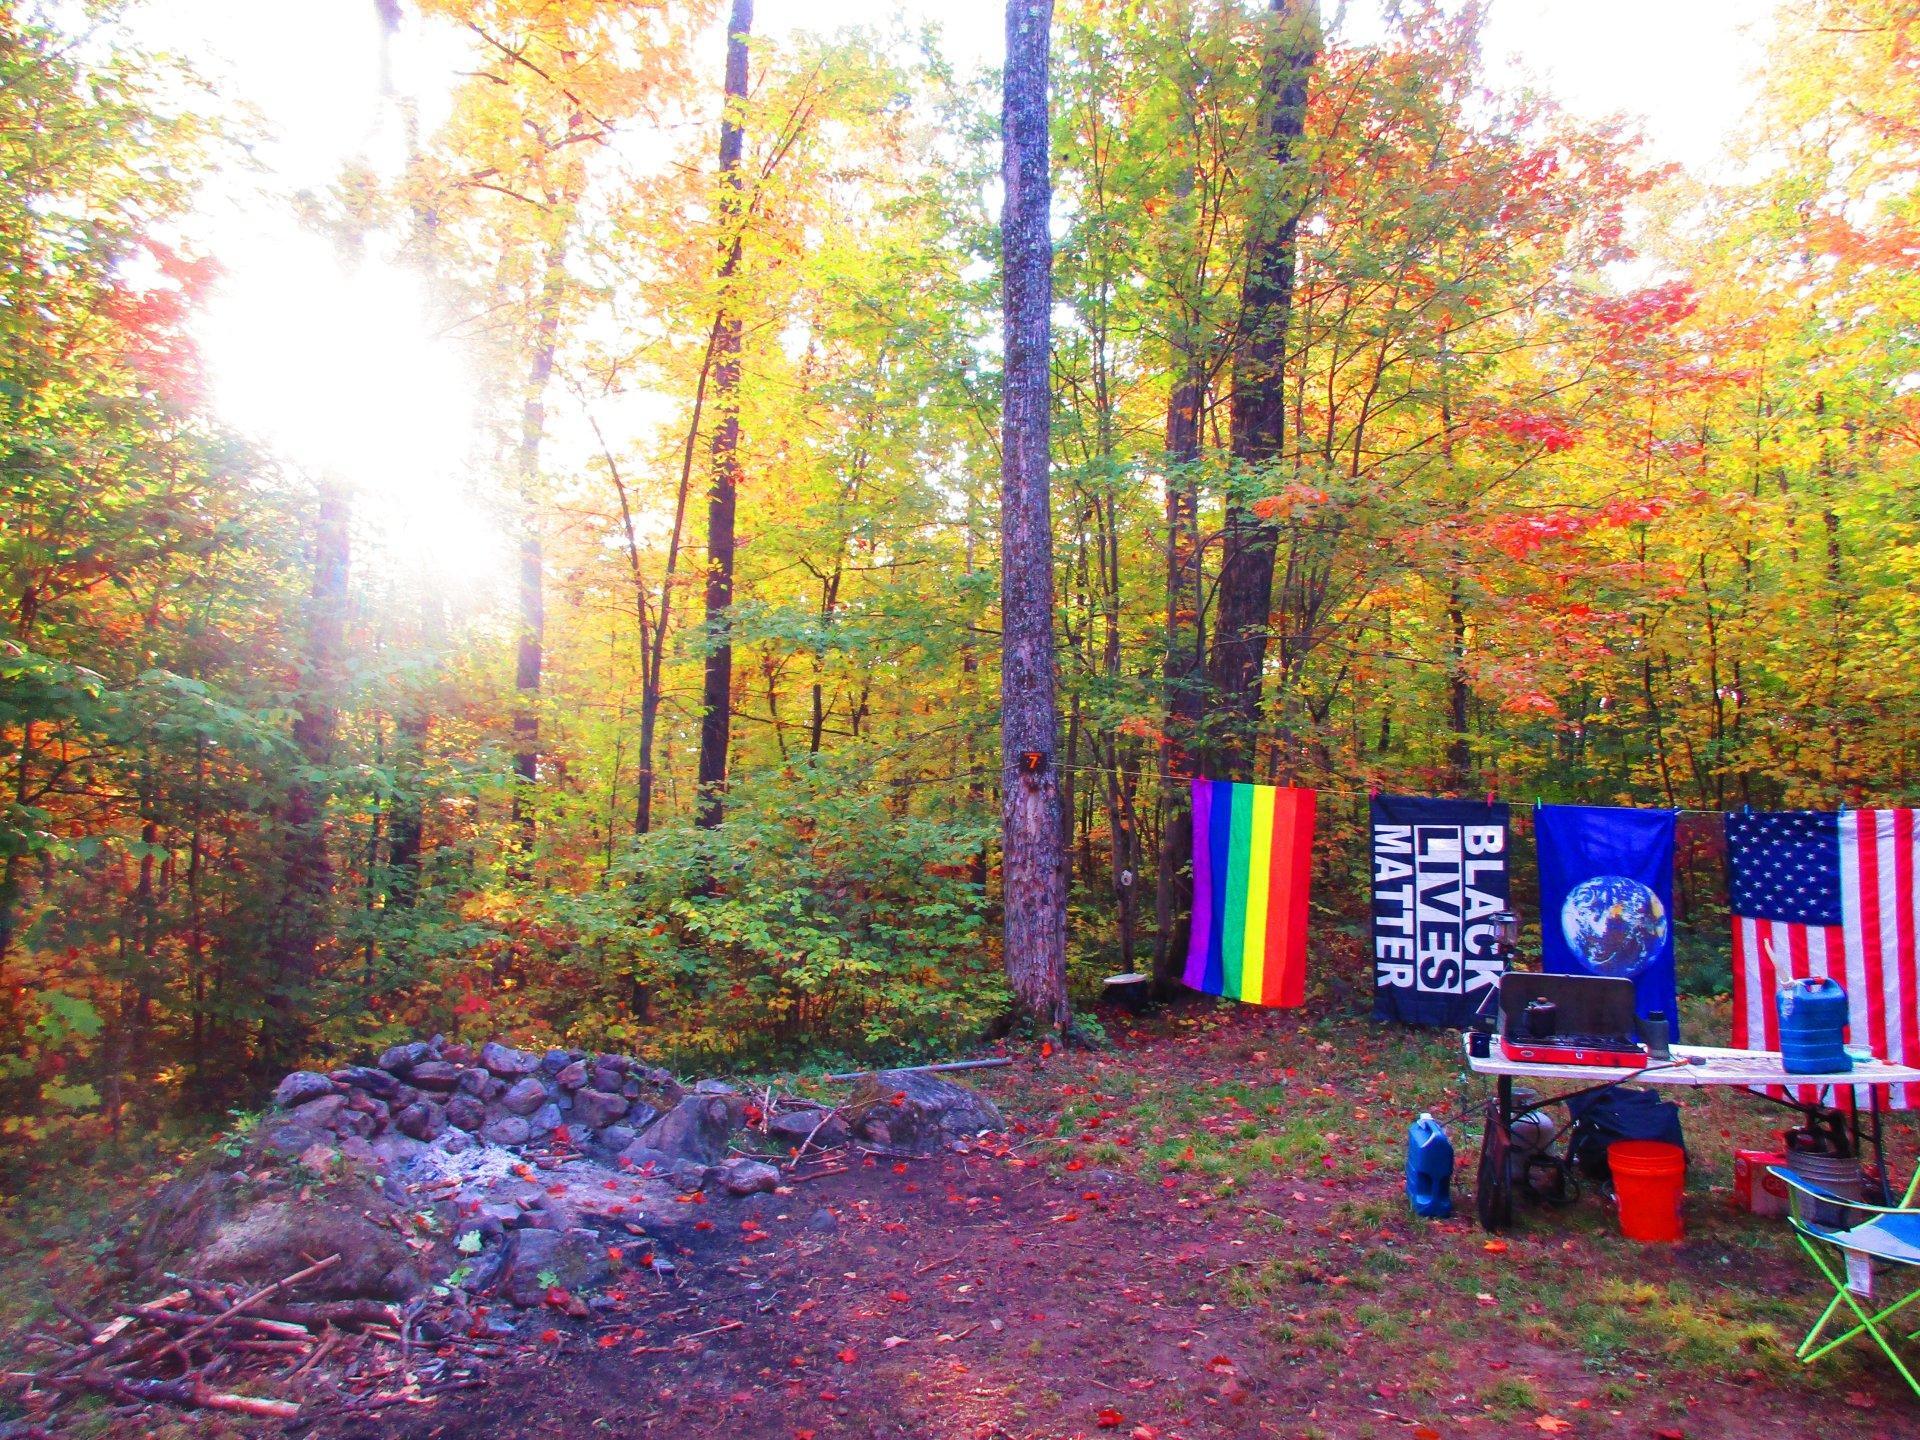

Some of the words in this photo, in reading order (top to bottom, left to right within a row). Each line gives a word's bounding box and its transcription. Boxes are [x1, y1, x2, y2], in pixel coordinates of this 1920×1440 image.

[1028, 756, 1039, 769] 7
[1374, 825, 1414, 988] MATTER
[1418, 827, 1460, 990] LIVES
[1464, 825, 1504, 993] BLACK
